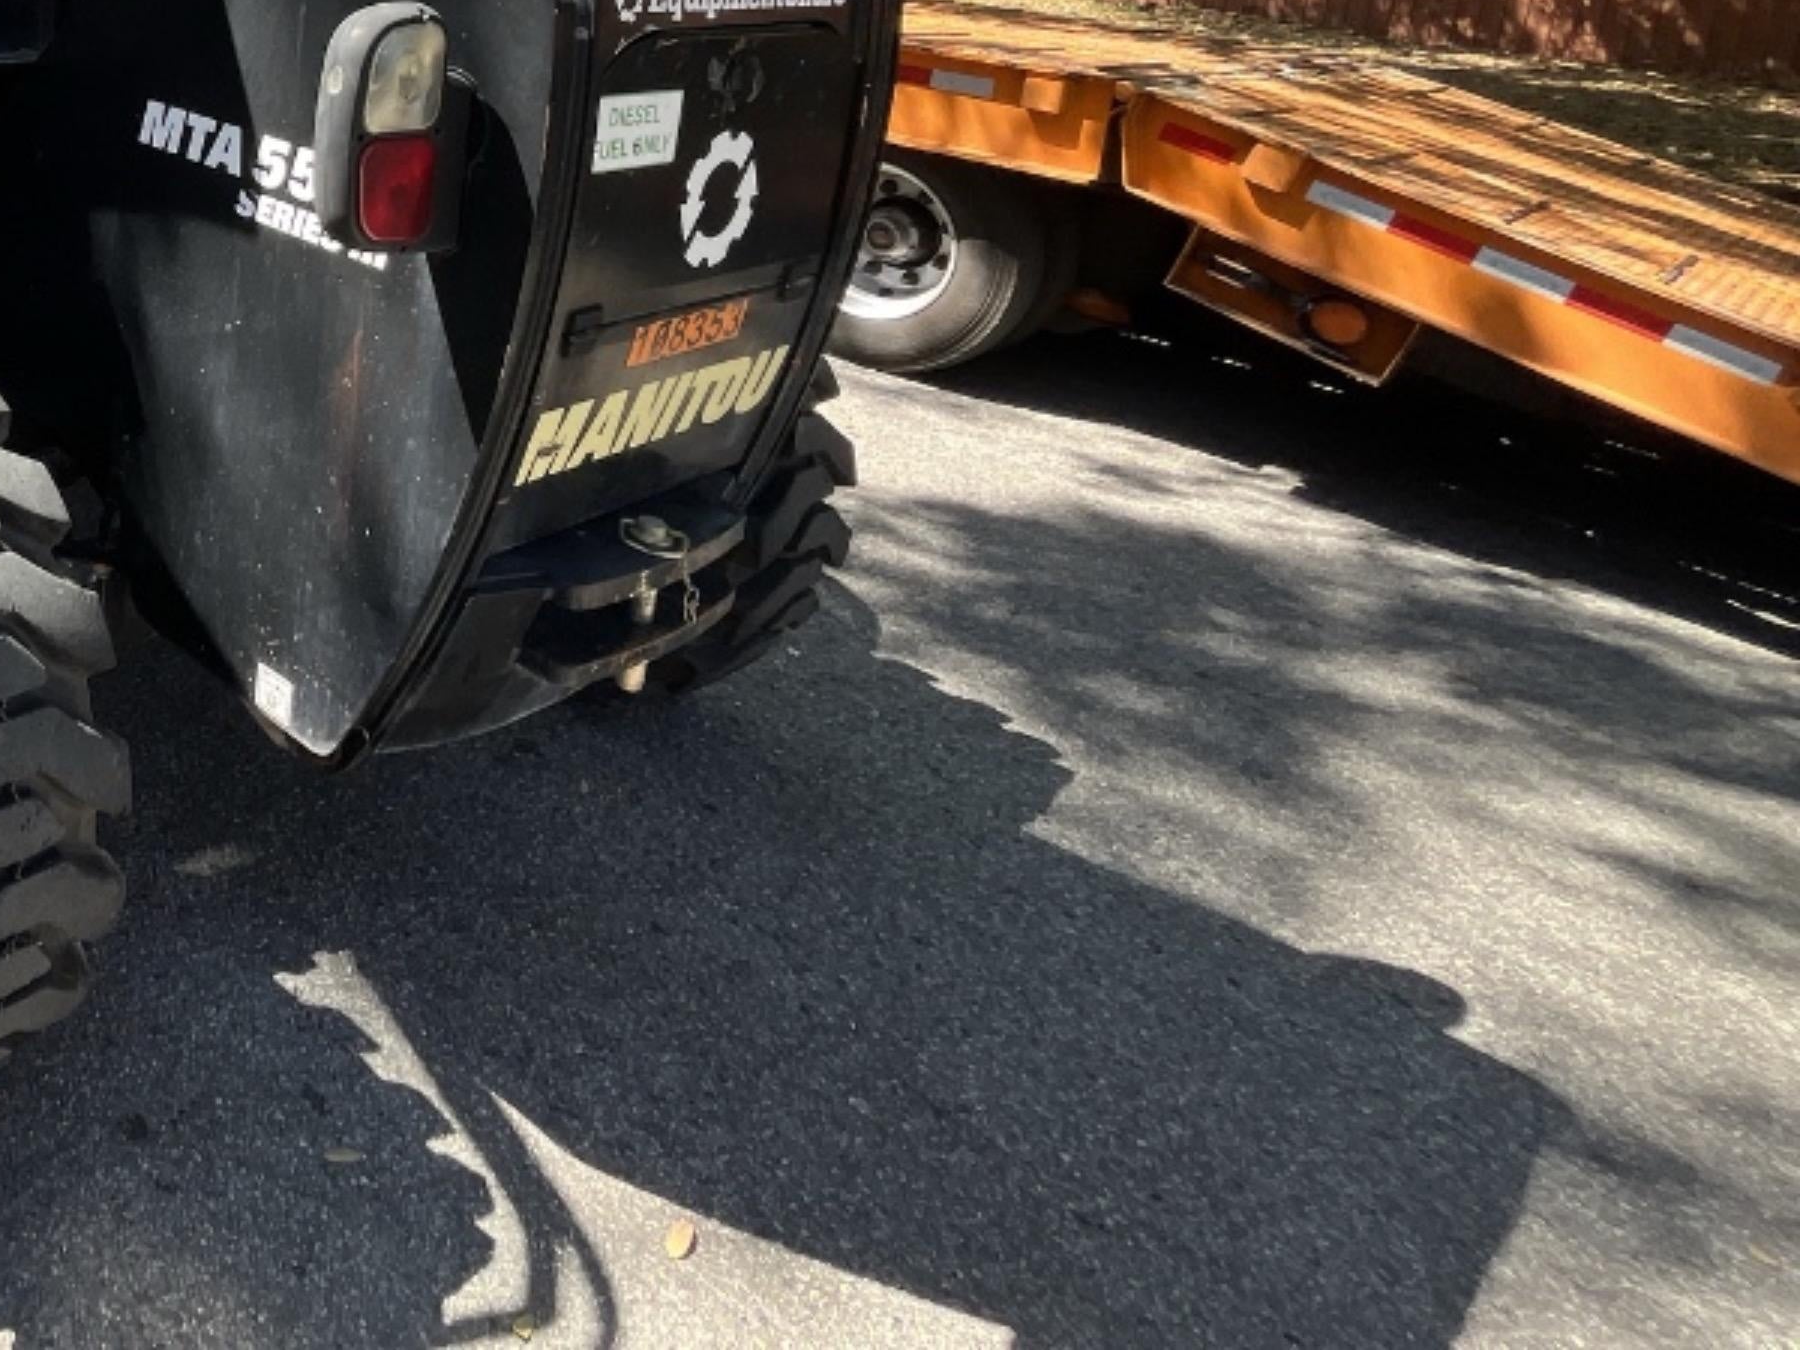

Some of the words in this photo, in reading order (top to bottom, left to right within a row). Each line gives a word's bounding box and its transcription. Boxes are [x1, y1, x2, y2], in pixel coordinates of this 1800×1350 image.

[138, 99, 242, 178] MTA
[252, 134, 317, 202] 55
[233, 189, 343, 253] SERIE
[514, 344, 791, 487] MANITOU
